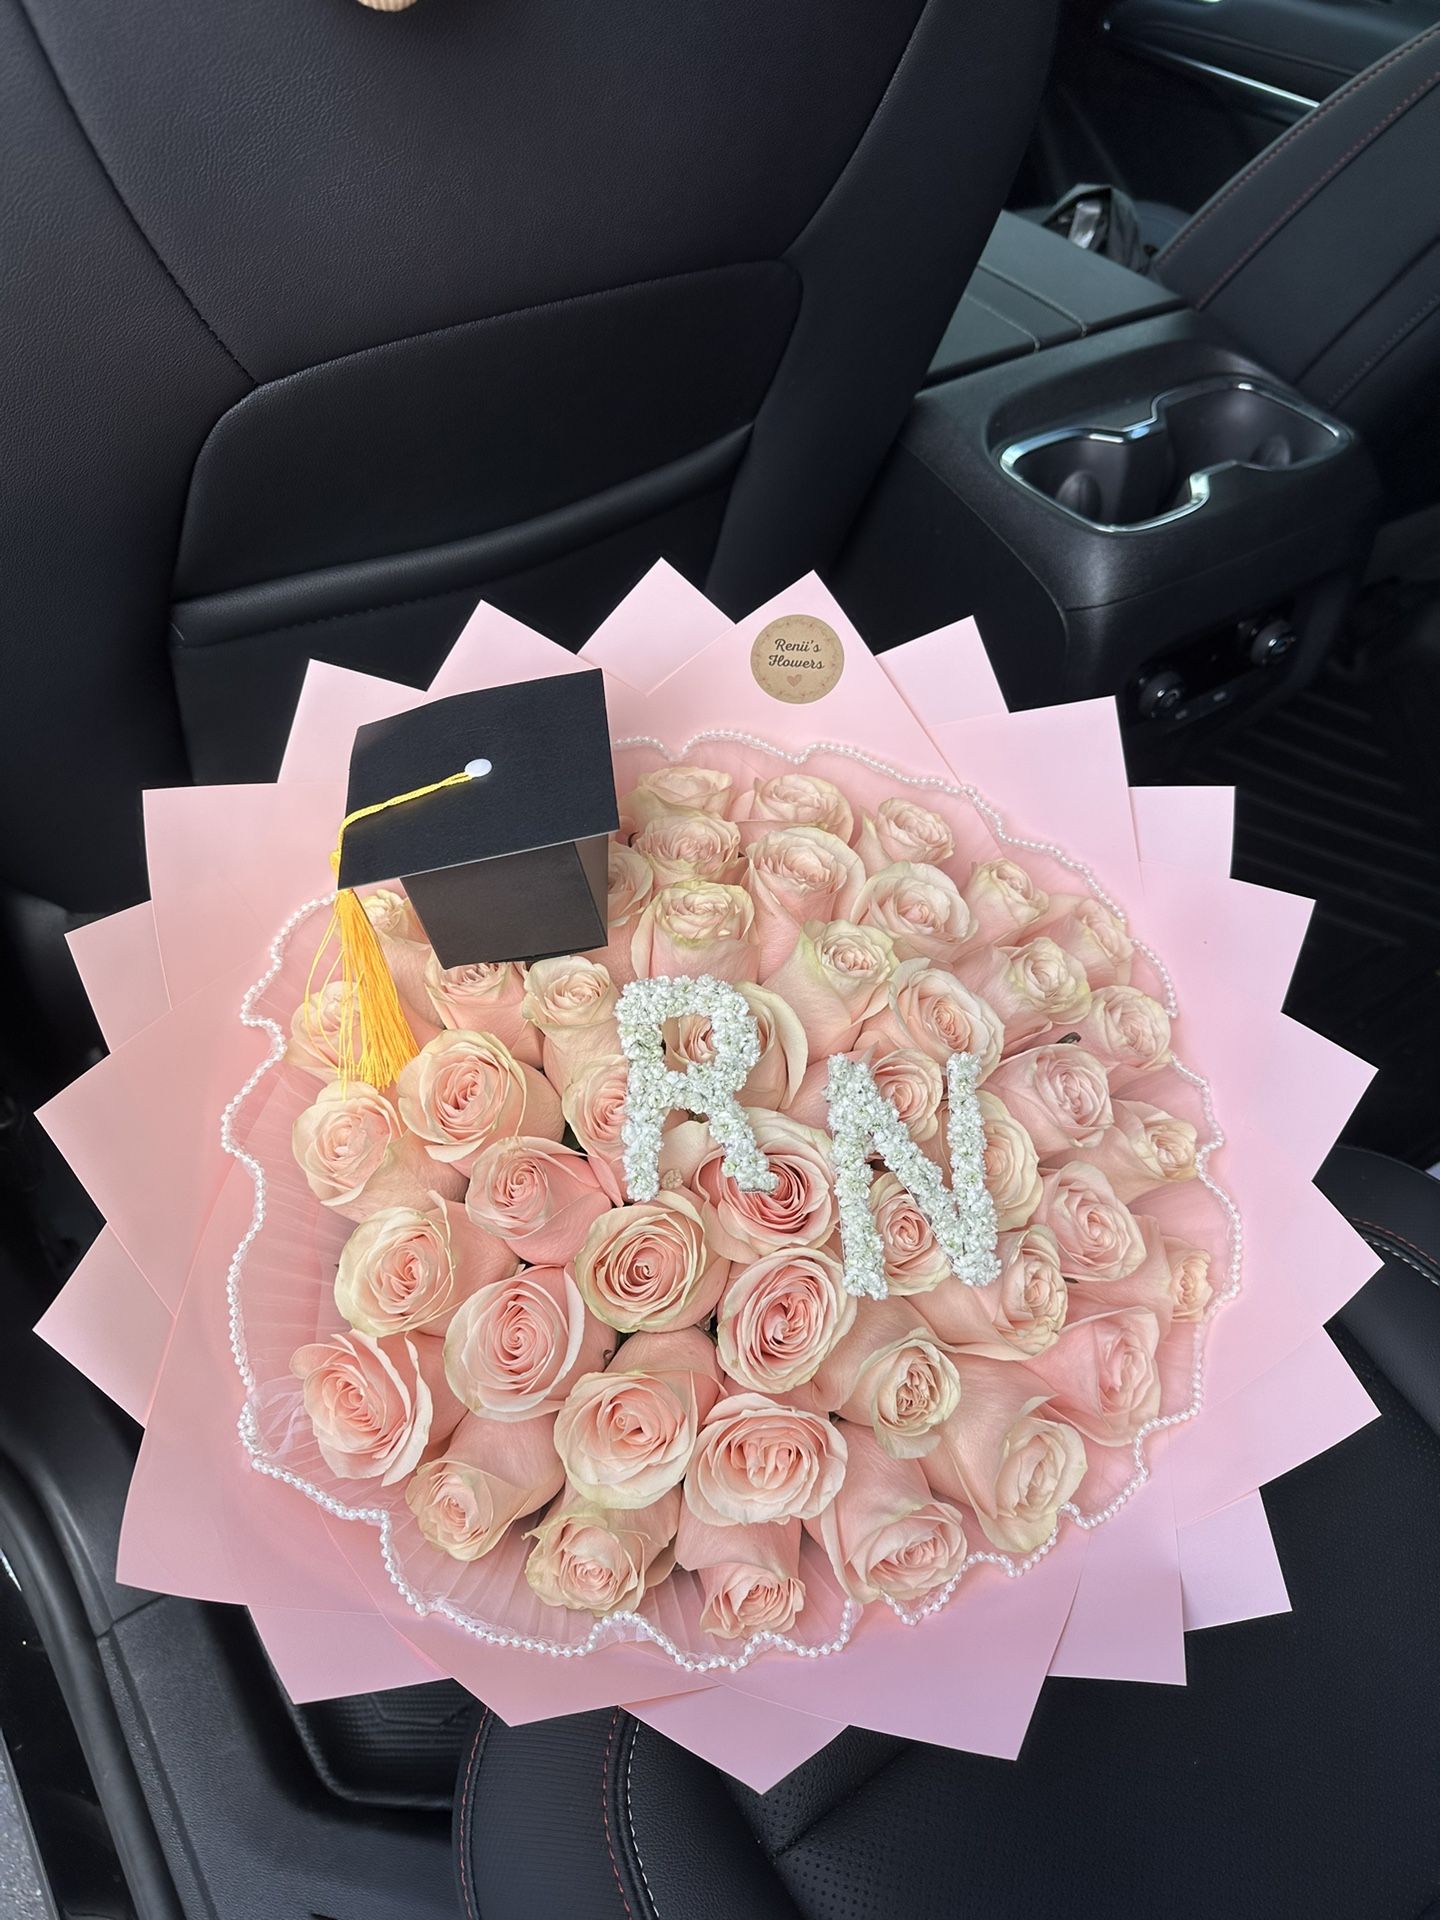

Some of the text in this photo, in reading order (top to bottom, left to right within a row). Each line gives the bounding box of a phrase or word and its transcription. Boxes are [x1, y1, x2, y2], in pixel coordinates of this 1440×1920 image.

[774, 638, 821, 653] Renii's
[768, 654, 824, 669] Flowers
[615, 974, 1001, 1300] RN
